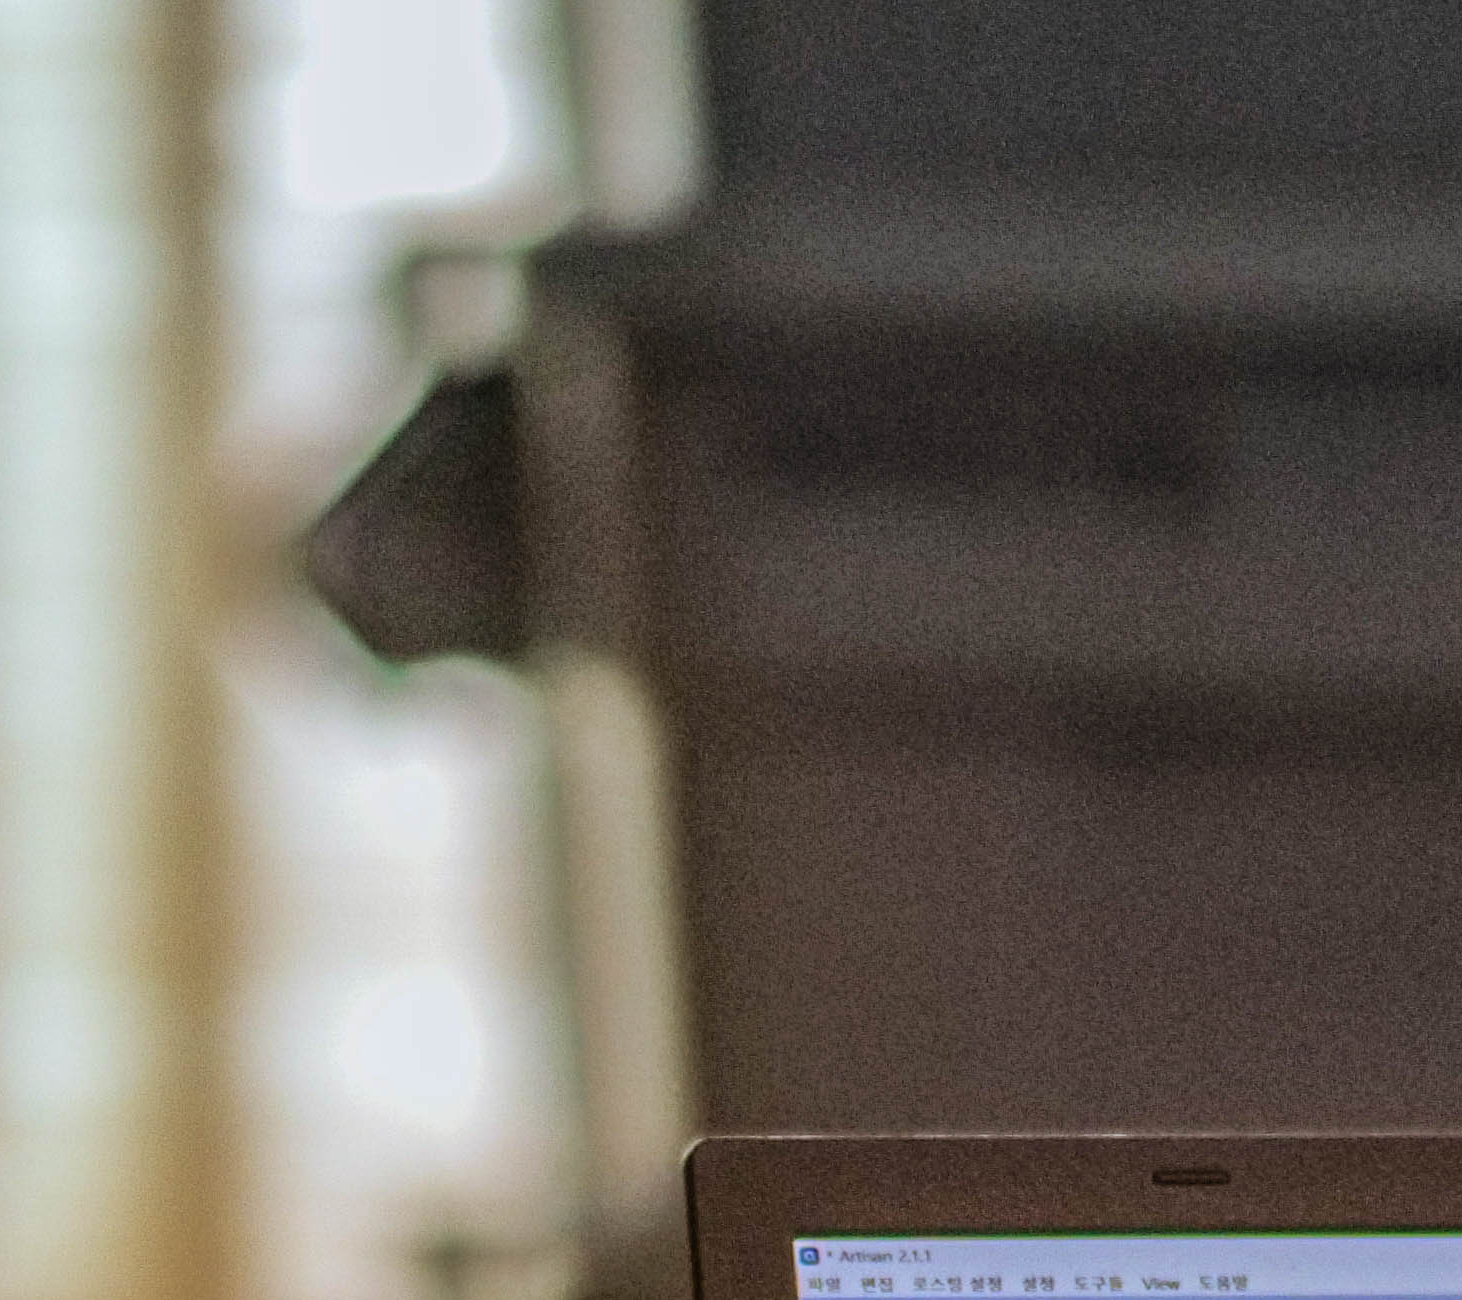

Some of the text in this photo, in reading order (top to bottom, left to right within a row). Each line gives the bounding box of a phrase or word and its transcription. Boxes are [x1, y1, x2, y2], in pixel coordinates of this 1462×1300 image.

[839, 1250, 932, 1262] Artisan 2.1.1
[1141, 1275, 1180, 1291] View
